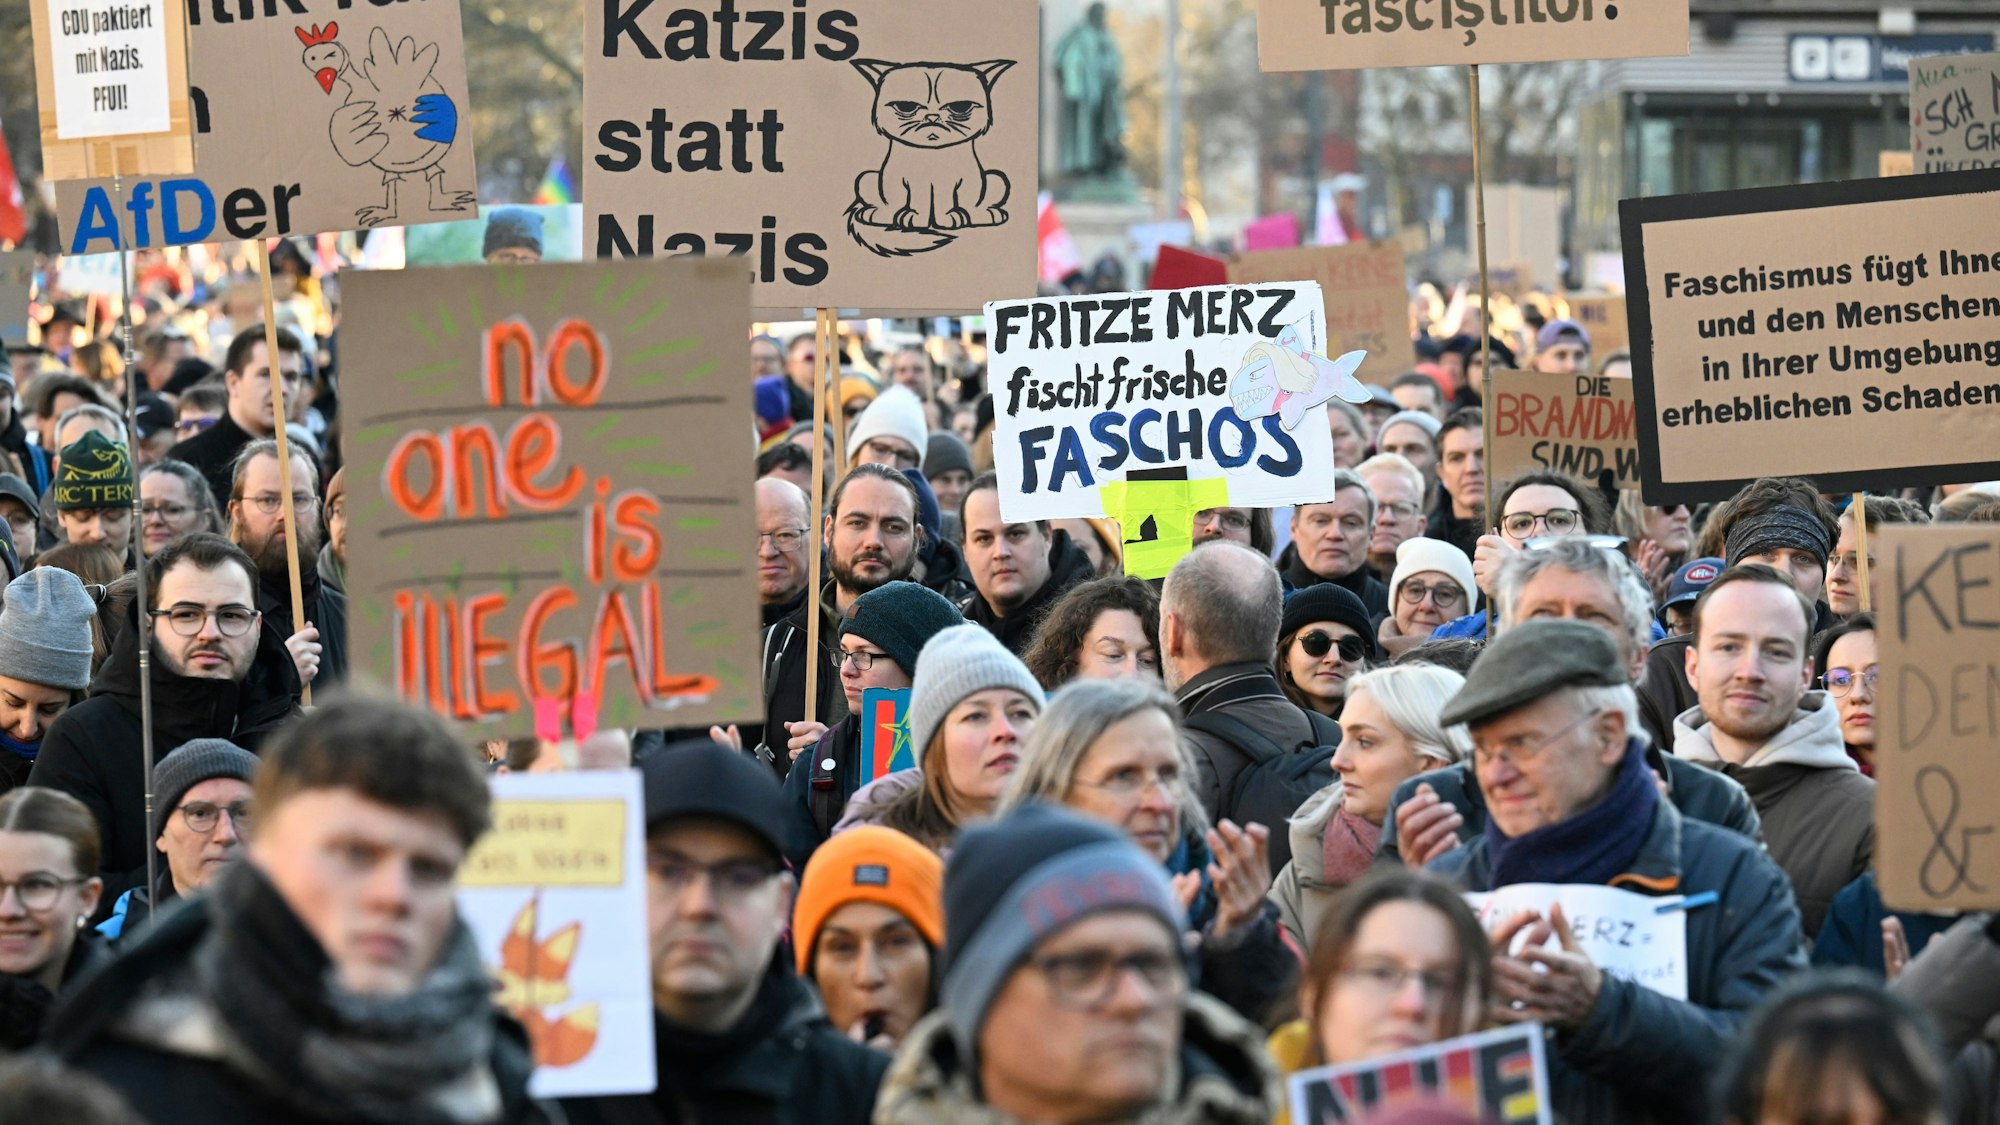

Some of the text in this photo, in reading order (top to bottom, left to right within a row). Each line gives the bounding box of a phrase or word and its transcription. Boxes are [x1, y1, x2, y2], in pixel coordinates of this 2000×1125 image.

[62, 4, 152, 36] CDU paktiert
[602, 0, 860, 61] Katzis
[75, 44, 143, 74] mit Nazis.
[93, 84, 128, 112] PFUI!
[595, 108, 785, 174] statt
[71, 179, 302, 254] AfDer
[1664, 262, 1852, 298] Faschismus
[1862, 253, 1929, 286] fügt
[994, 297, 1153, 353] FRITZE
[1166, 289, 1296, 340] MERZ
[1698, 294, 2000, 338] und den Menschen
[482, 314, 611, 407] no
[1007, 348, 1228, 417] fischt frische
[1576, 376, 1611, 397] DIE
[1702, 339, 2000, 381] in Ihrer Umgebung
[1662, 380, 2000, 427] erheblichen Schaden
[382, 413, 586, 522] one
[1019, 406, 1303, 494] FASCHOS
[1531, 440, 1604, 480] SIND
[583, 476, 662, 585] is
[1896, 541, 2000, 642] KE
[1914, 764, 1995, 899] &
